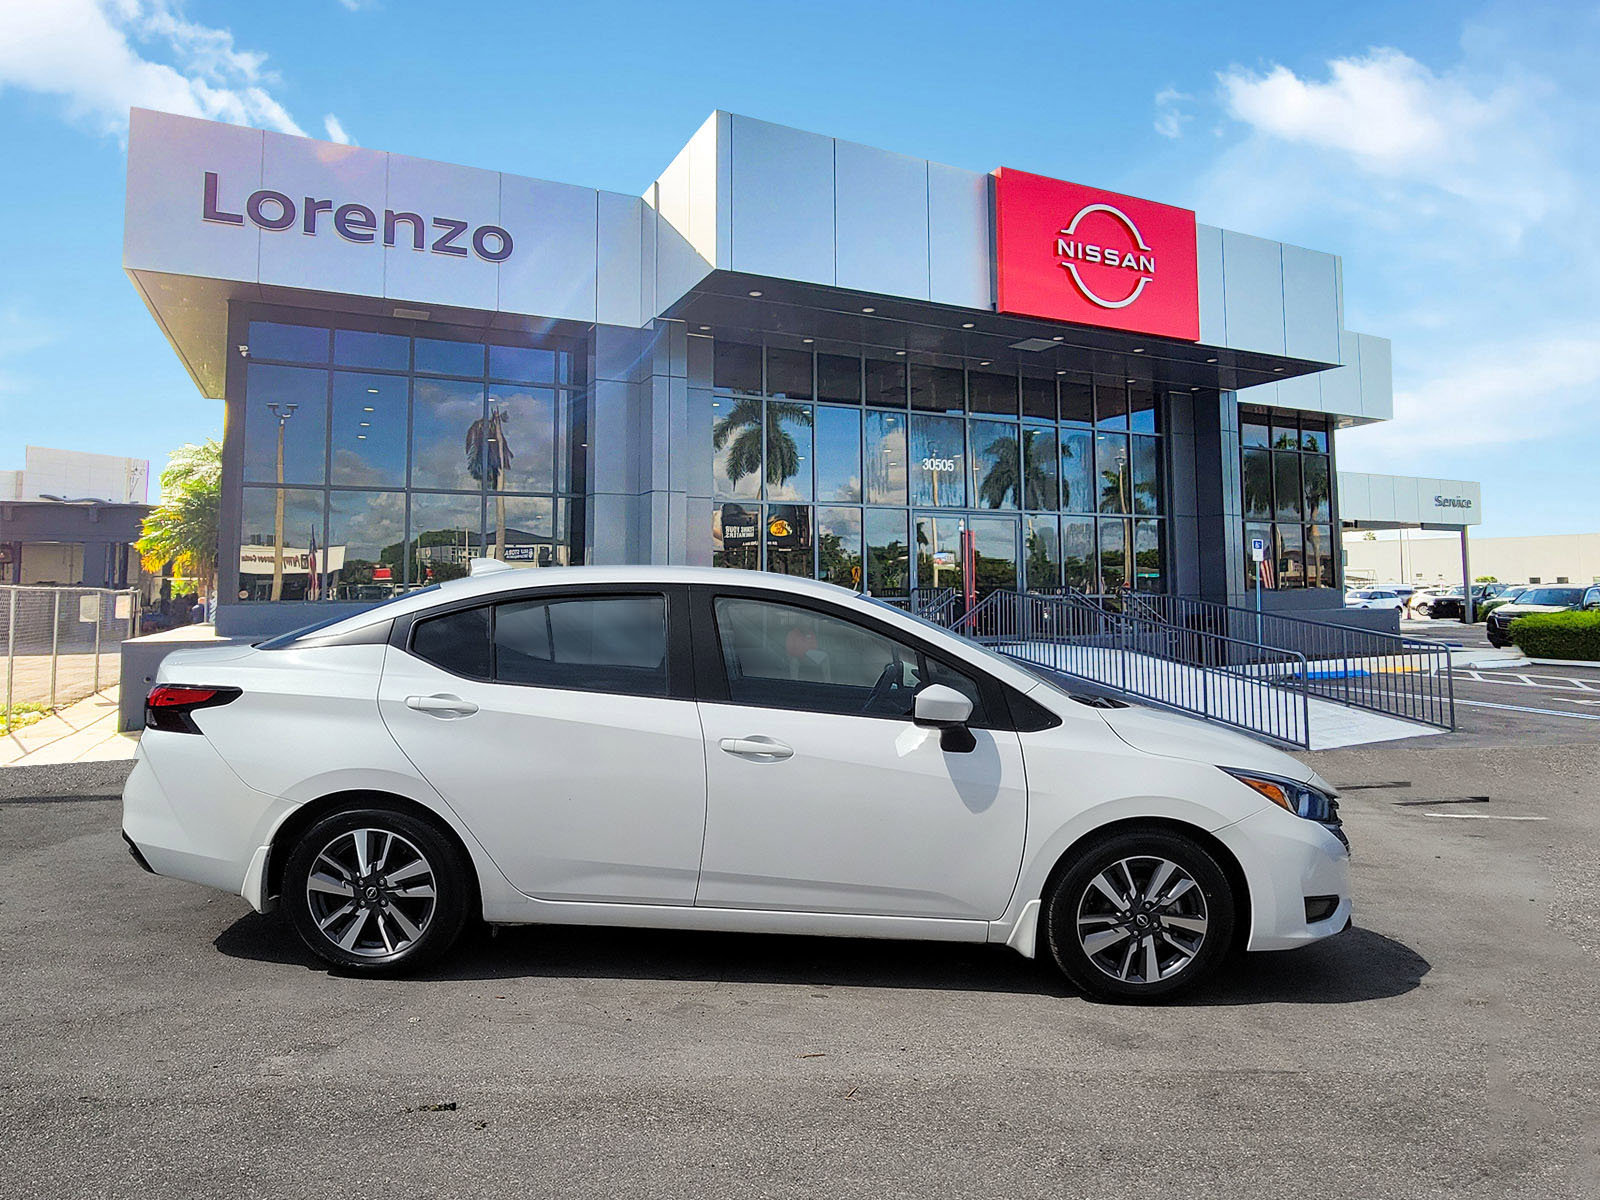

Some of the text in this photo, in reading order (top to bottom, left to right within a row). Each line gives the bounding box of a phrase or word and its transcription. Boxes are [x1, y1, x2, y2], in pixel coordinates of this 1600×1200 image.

[202, 171, 515, 263] Lorenzo
[1057, 238, 1155, 273] NISSAN
[922, 457, 955, 472] 30505
[1434, 495, 1472, 509] Service
